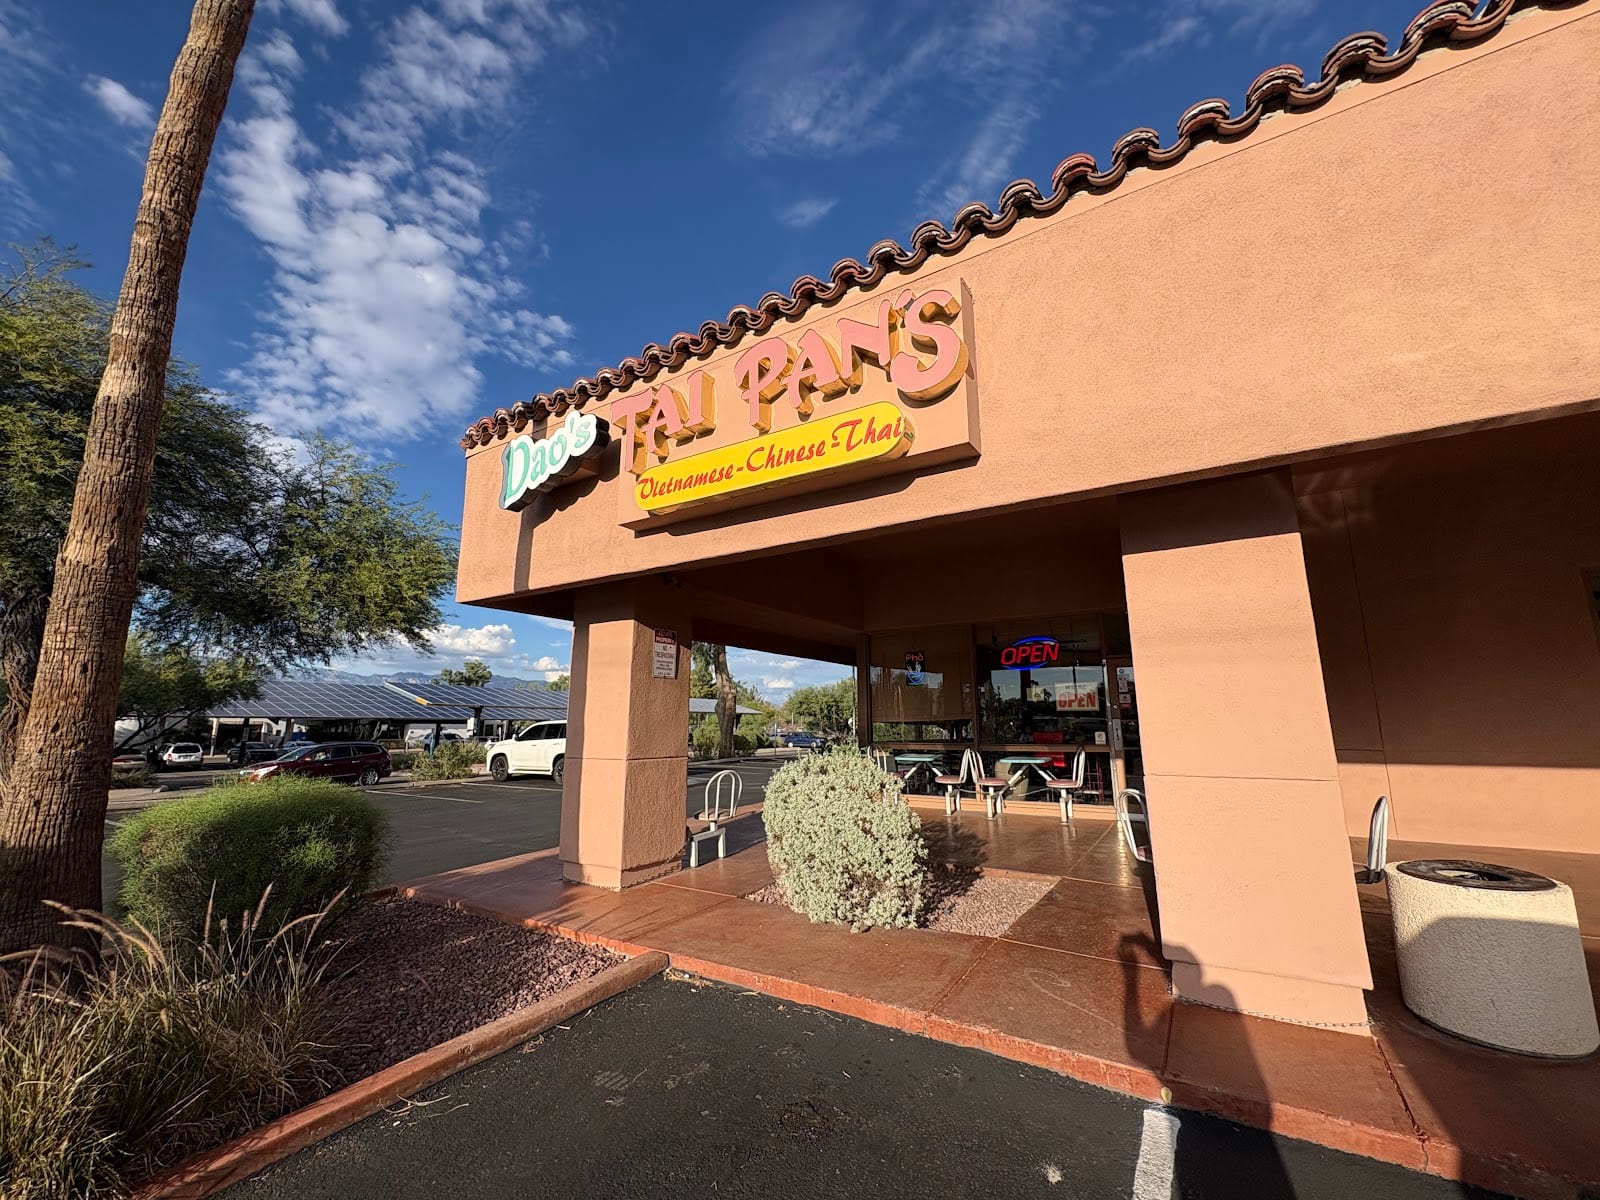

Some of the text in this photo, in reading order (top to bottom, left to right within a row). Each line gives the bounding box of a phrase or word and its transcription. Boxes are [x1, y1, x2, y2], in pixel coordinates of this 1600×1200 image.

[612, 288, 962, 472] TAI PAN'S
[503, 415, 592, 503] Dao's
[1001, 642, 1060, 665] OPEN
[1058, 691, 1097, 709] OPEN
